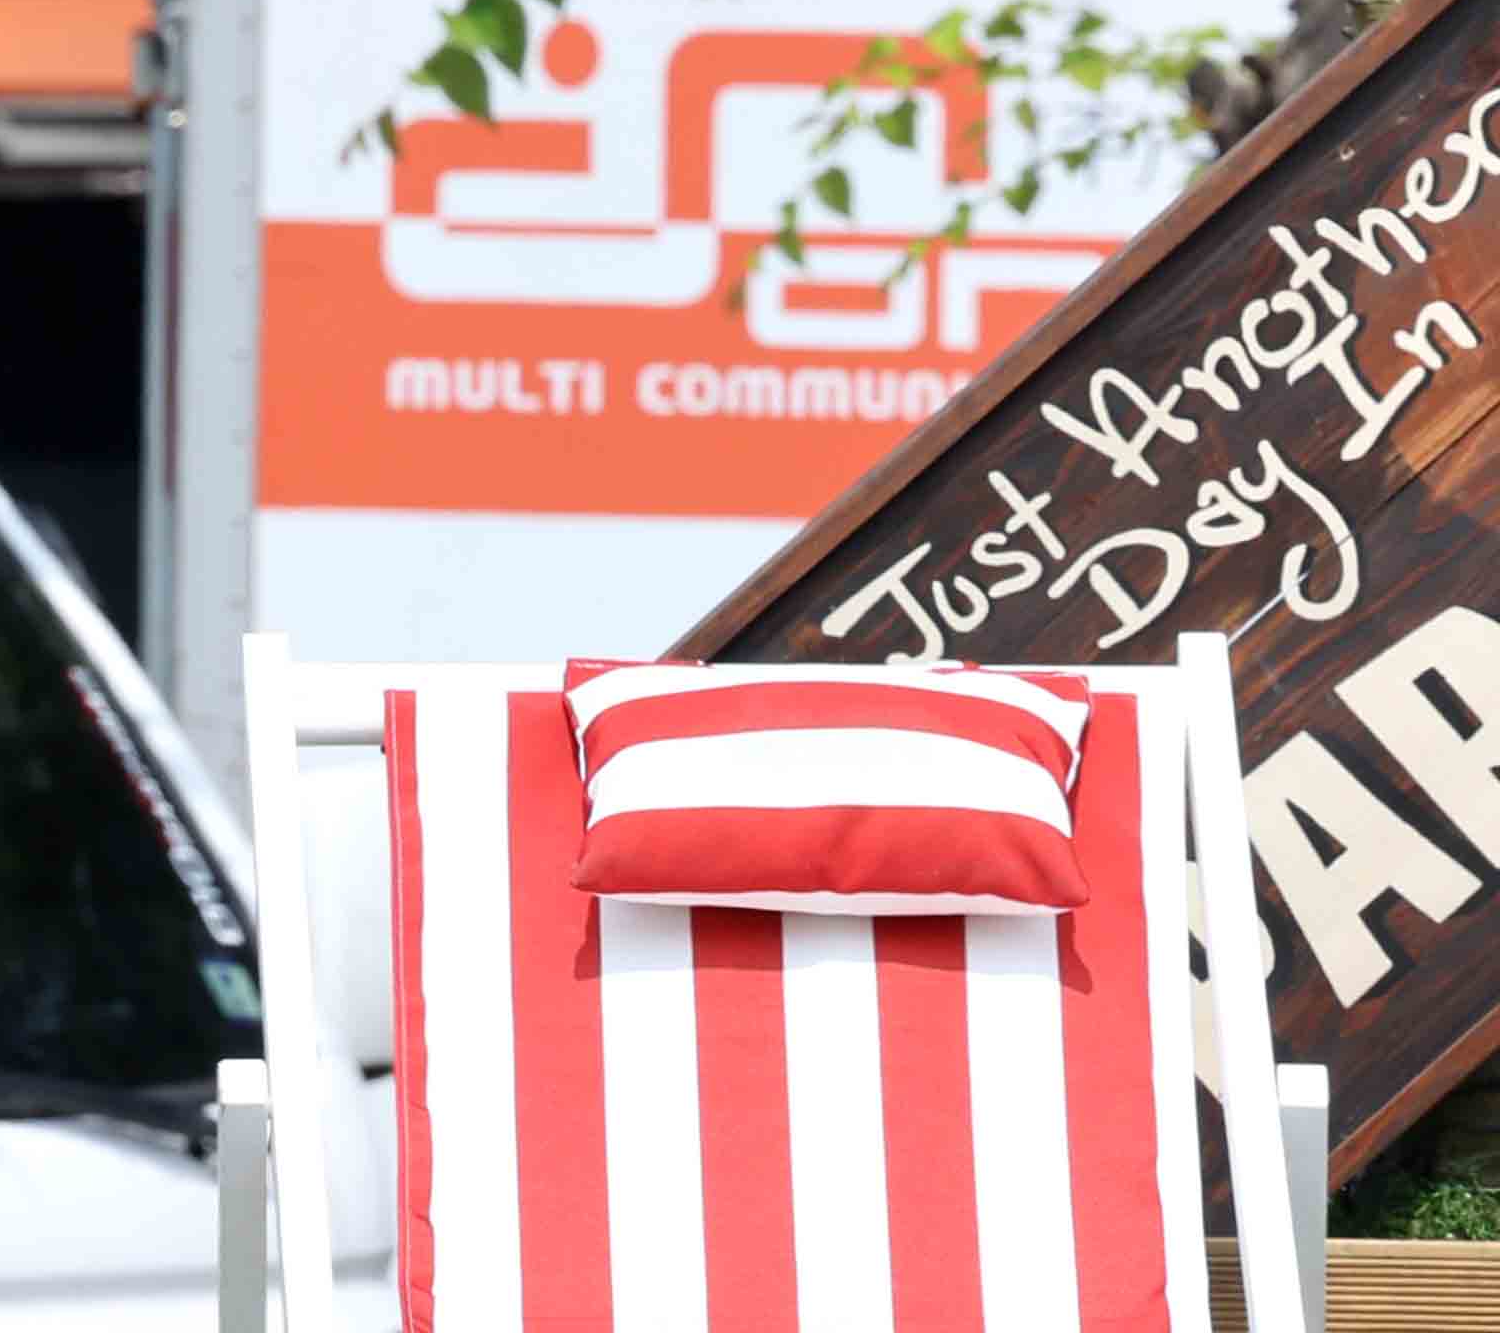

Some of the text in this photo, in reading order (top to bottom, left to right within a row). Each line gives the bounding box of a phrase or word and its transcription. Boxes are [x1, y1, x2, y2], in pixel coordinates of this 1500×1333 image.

[384, 355, 608, 416] MULTI
[1048, 299, 1480, 650] Day In
[822, 470, 1067, 665] Just
